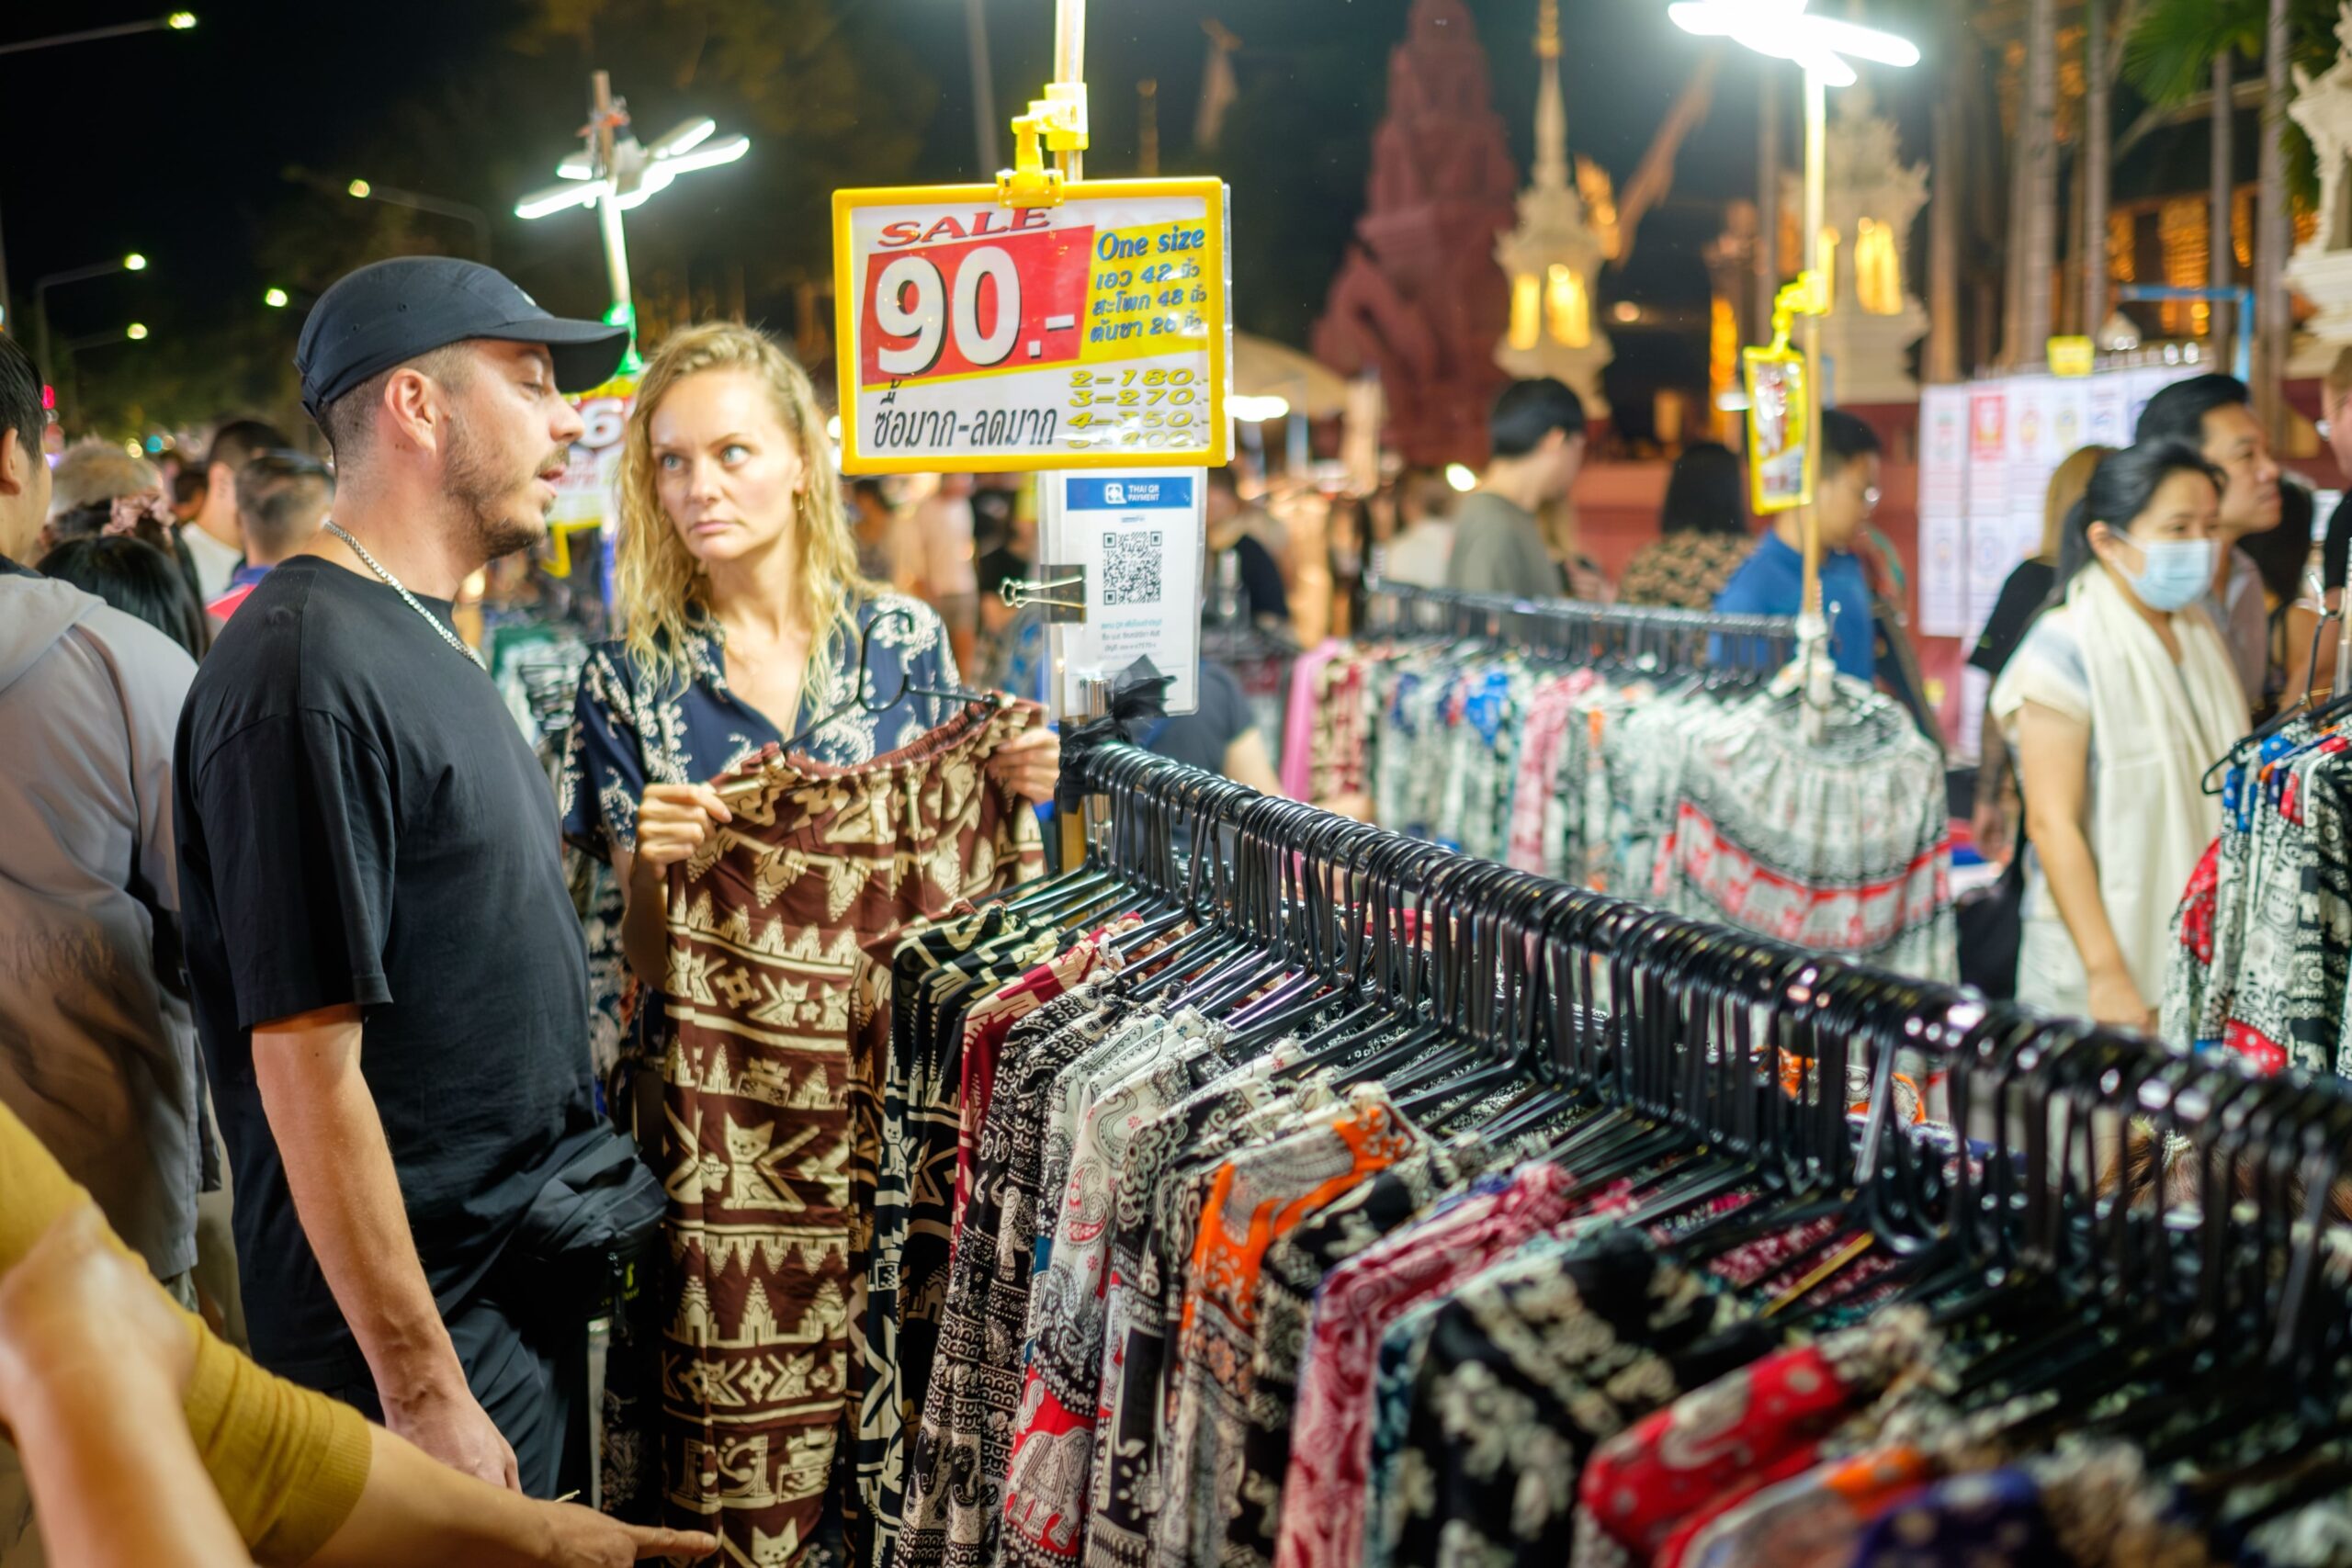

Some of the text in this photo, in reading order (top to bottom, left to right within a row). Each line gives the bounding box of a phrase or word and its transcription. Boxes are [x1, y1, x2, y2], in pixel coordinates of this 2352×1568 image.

[877, 207, 1052, 247] SALE
[1097, 225, 1205, 261] One size
[1095, 269, 1133, 290] เอว
[1140, 263, 1172, 284] 42
[1092, 289, 1151, 316] สะโพก
[1158, 288, 1184, 307] 48
[1148, 316, 1177, 335] 26
[1128, 484, 1159, 493] THAI QR
[1128, 493, 1160, 502] PAYMENT
